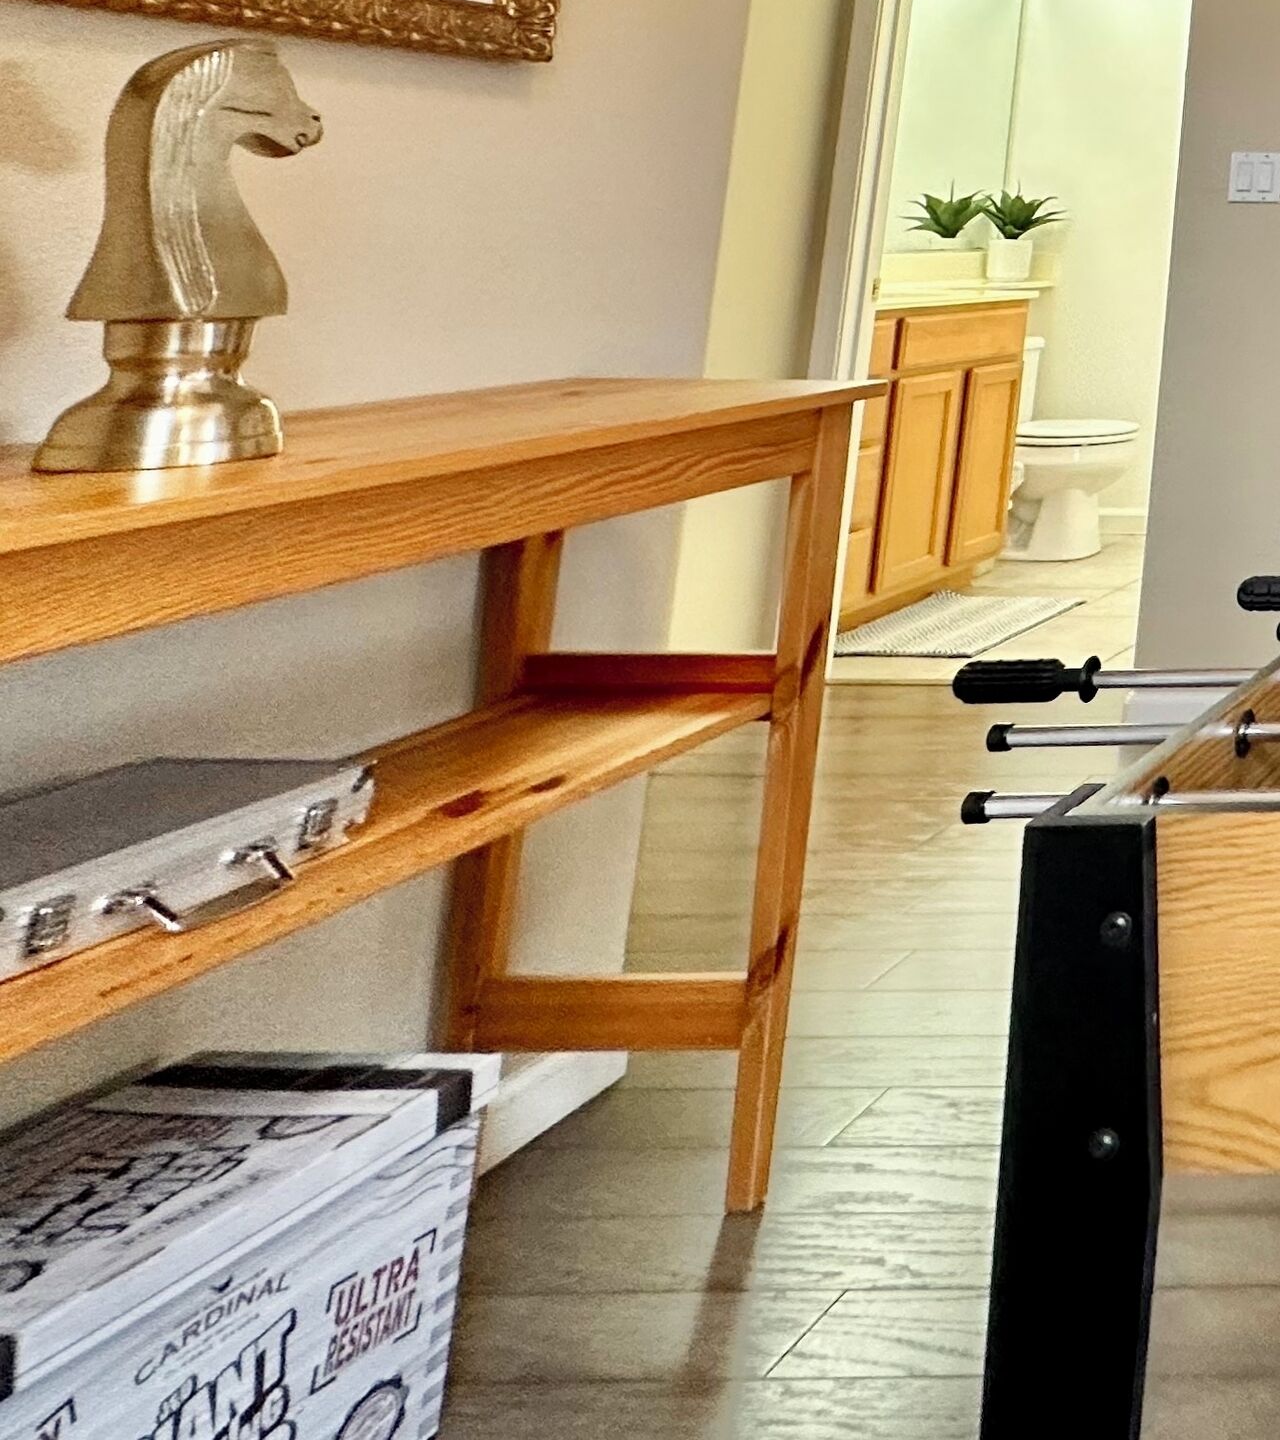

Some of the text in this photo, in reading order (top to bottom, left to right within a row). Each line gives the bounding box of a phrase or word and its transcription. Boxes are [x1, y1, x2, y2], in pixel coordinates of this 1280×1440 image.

[134, 1273, 290, 1386] CARDINAL
[335, 1247, 419, 1326] ULTRA
[323, 1288, 416, 1377] RESISTANT
